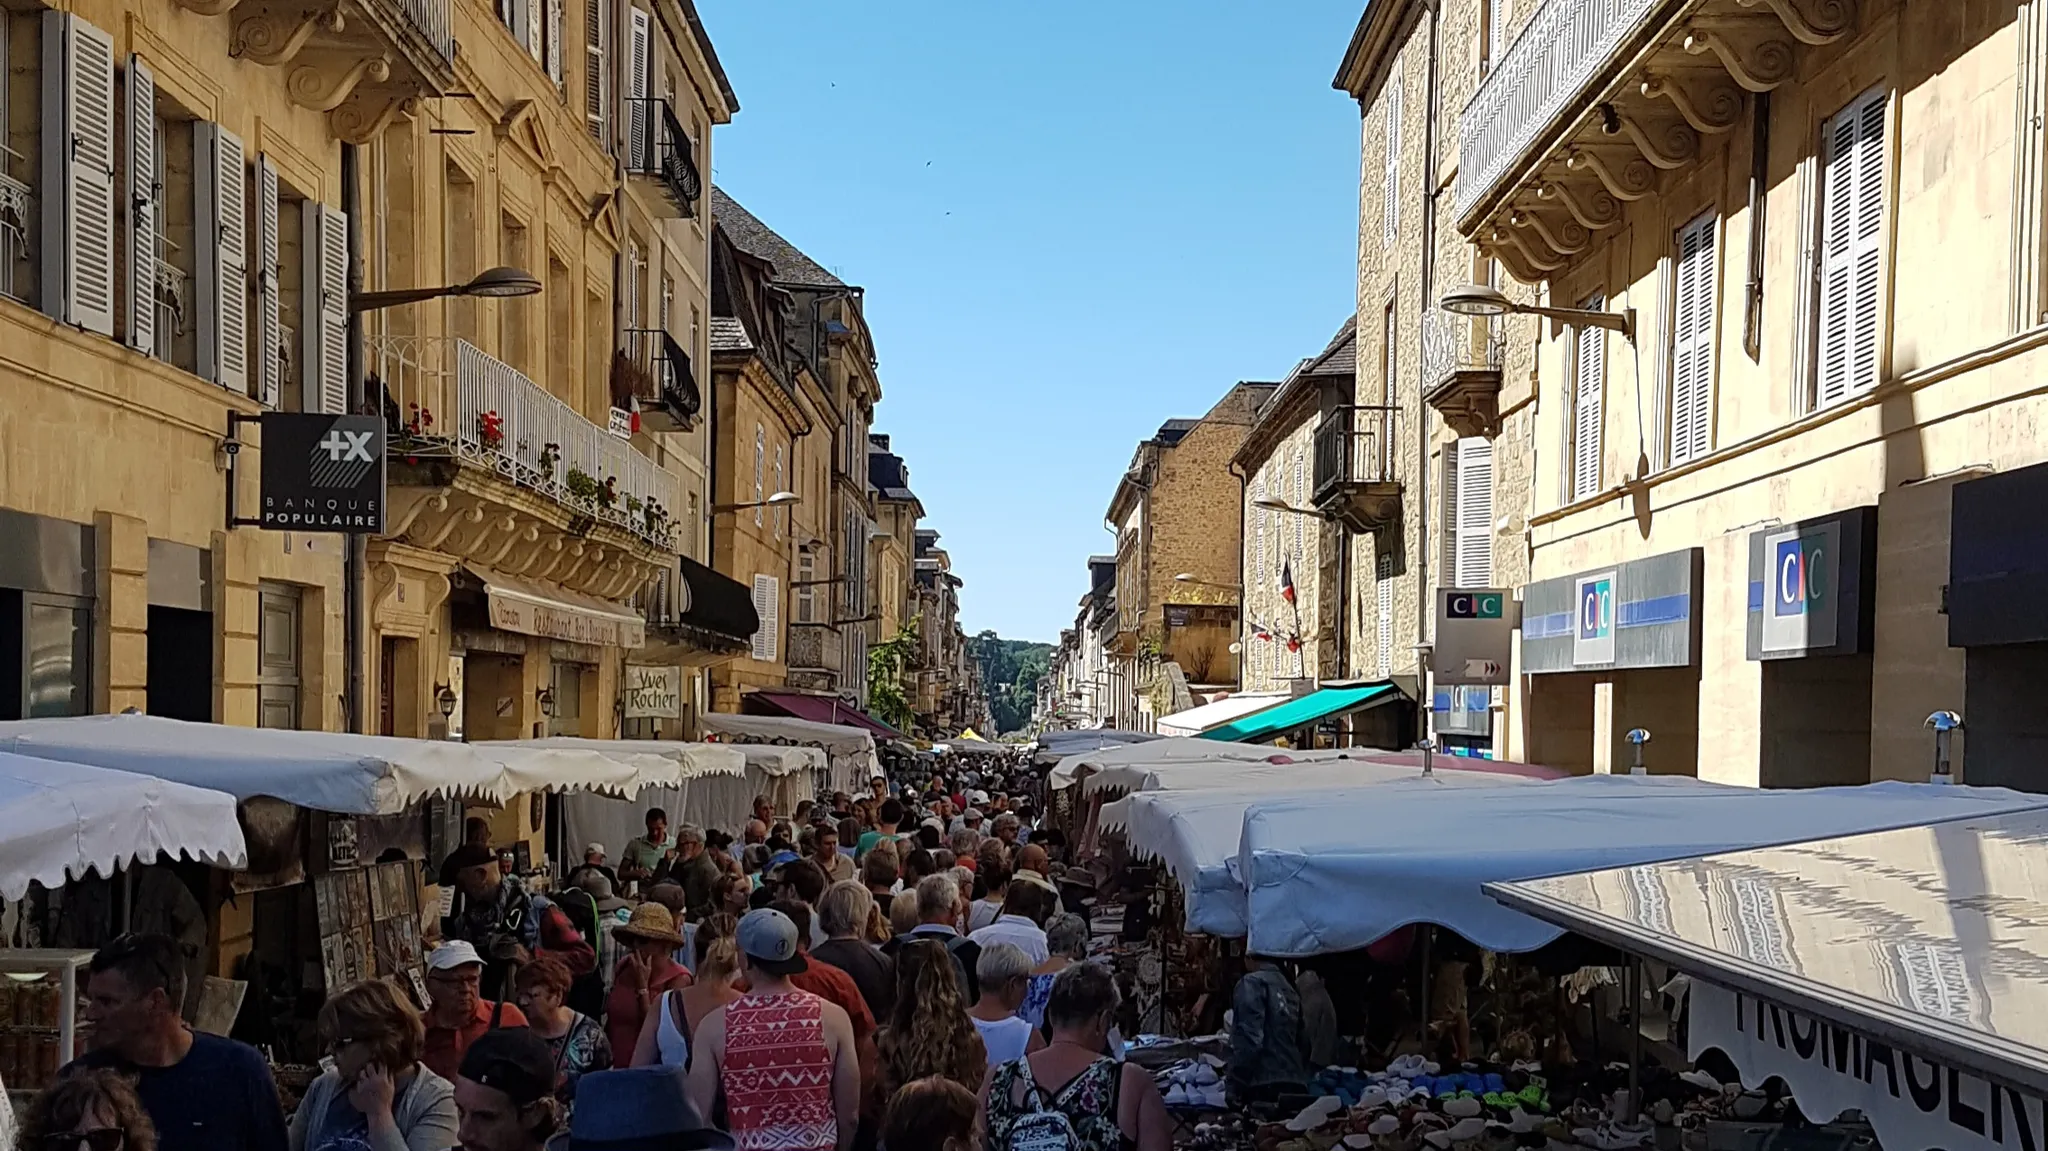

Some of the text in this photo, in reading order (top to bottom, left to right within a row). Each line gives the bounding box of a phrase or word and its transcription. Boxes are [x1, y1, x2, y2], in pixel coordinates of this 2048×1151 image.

[266, 497, 375, 511] BANQUE
[265, 512, 376, 526] POPULAIRE
[1781, 548, 1823, 604] CIC
[1453, 594, 1496, 614] CIC
[1585, 589, 1609, 631] CIC
[639, 669, 667, 691] Yves
[630, 689, 676, 710] Rocher
